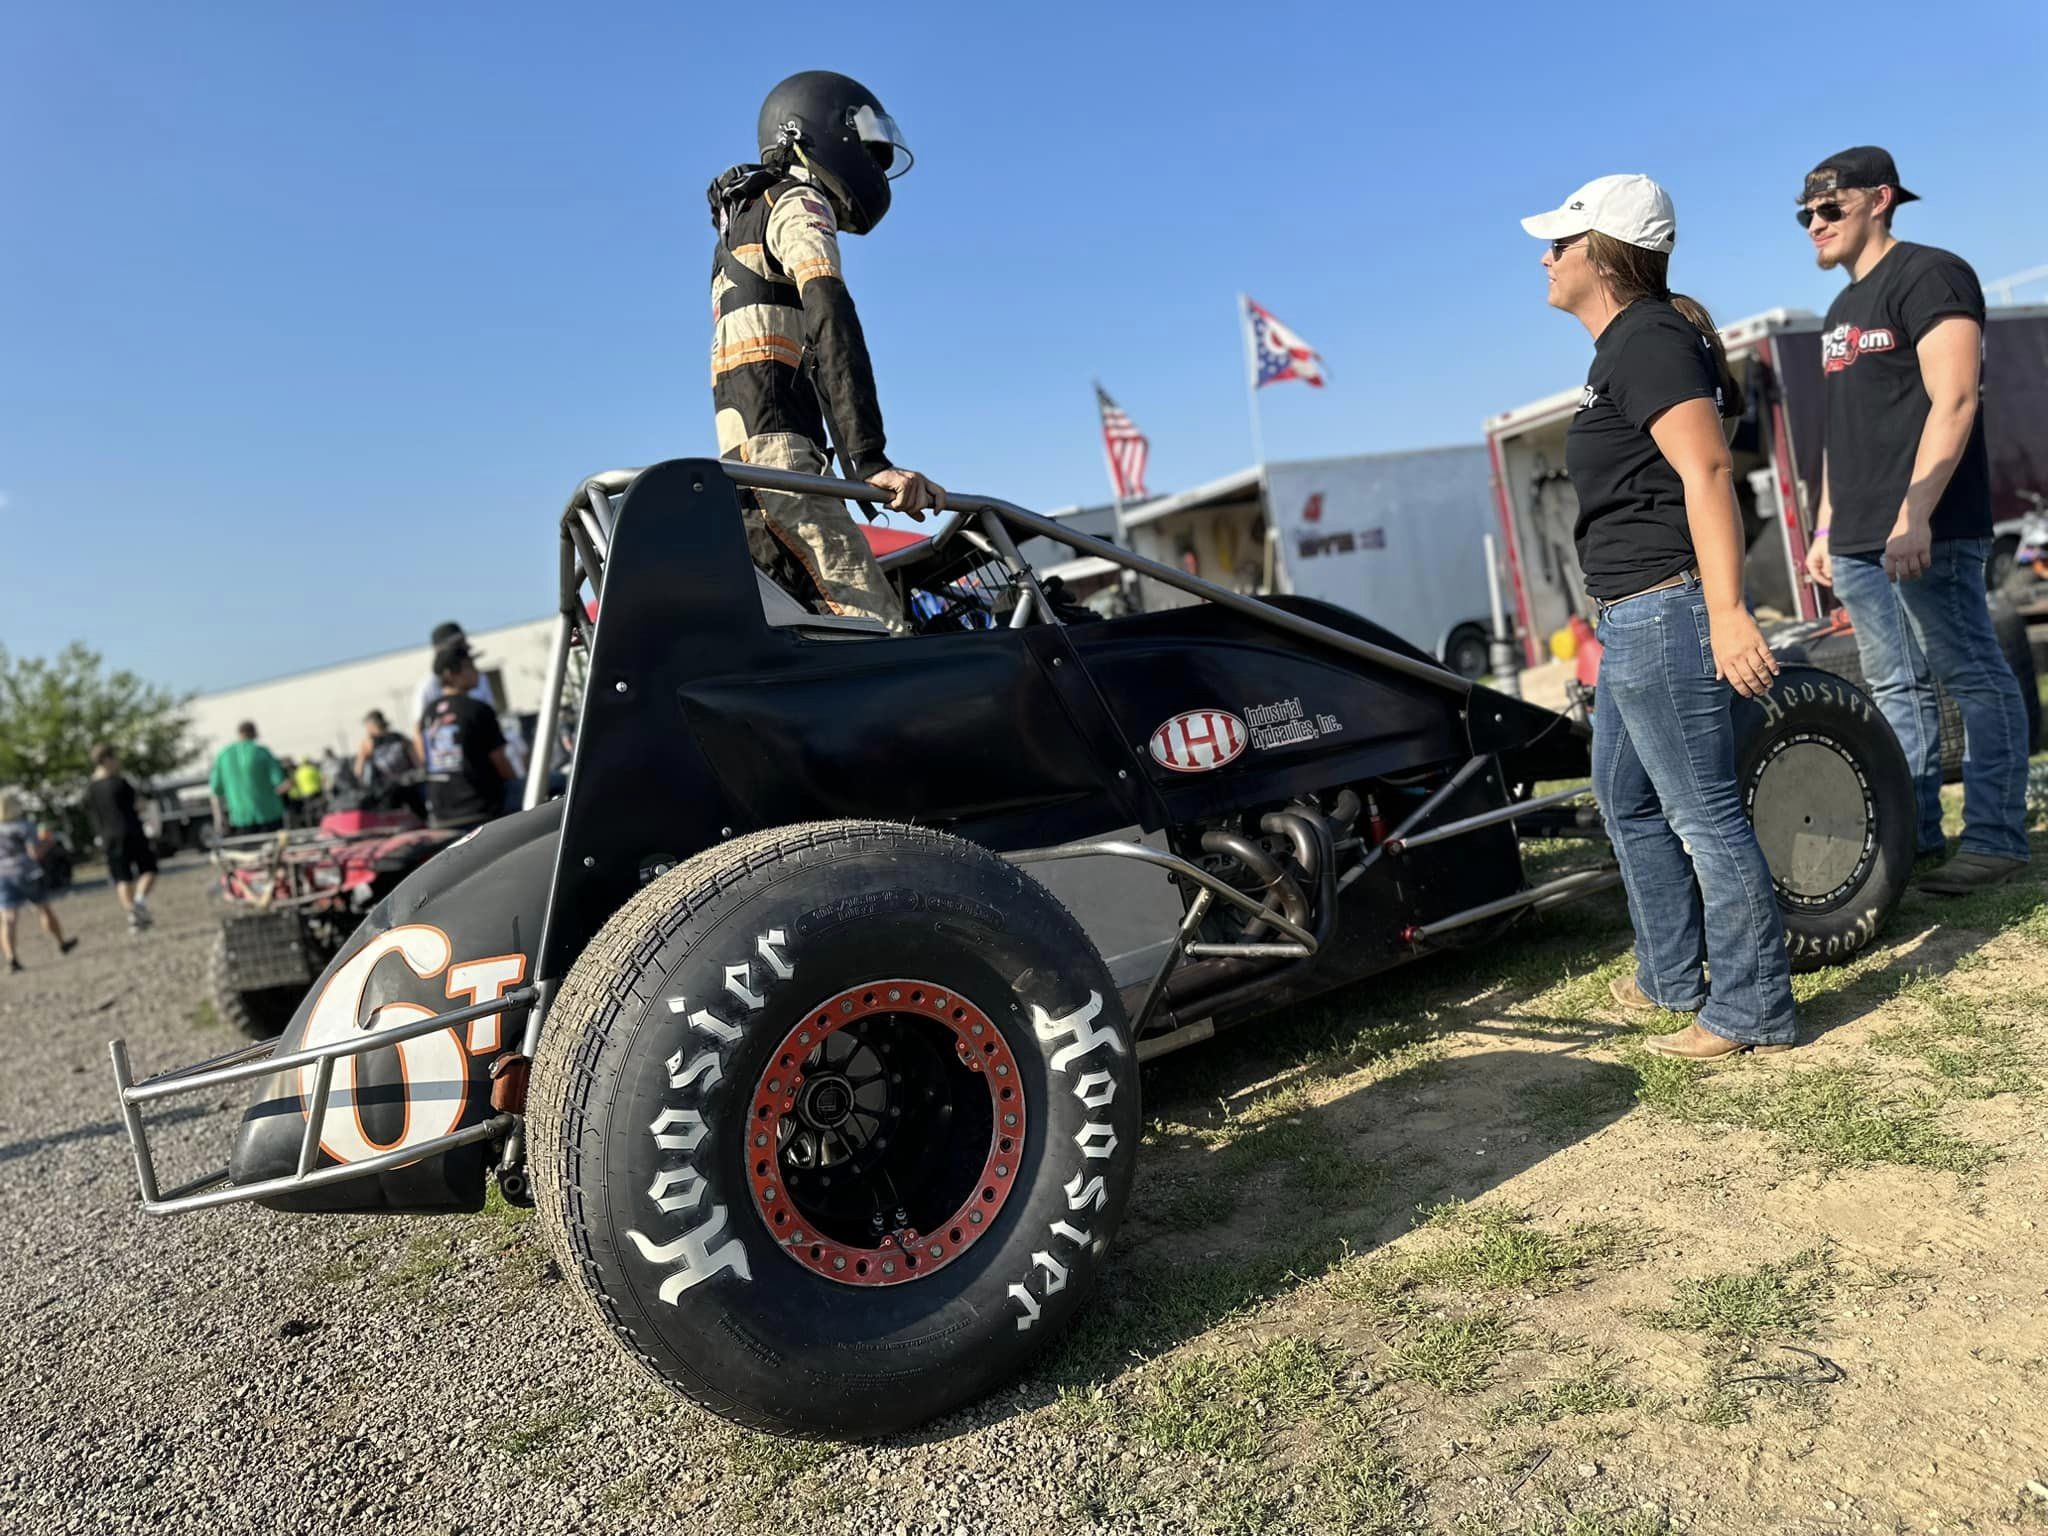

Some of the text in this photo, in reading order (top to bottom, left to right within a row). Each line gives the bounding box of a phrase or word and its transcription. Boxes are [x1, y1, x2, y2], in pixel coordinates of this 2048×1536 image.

[1244, 698, 1303, 727] Industrial
[1753, 681, 1873, 728] Hoosier
[1158, 713, 1241, 767] IHI
[1250, 713, 1343, 749] Hydraulics, Inc.
[626, 929, 799, 1307] Hoosier
[1007, 989, 1127, 1331] Hoosier
